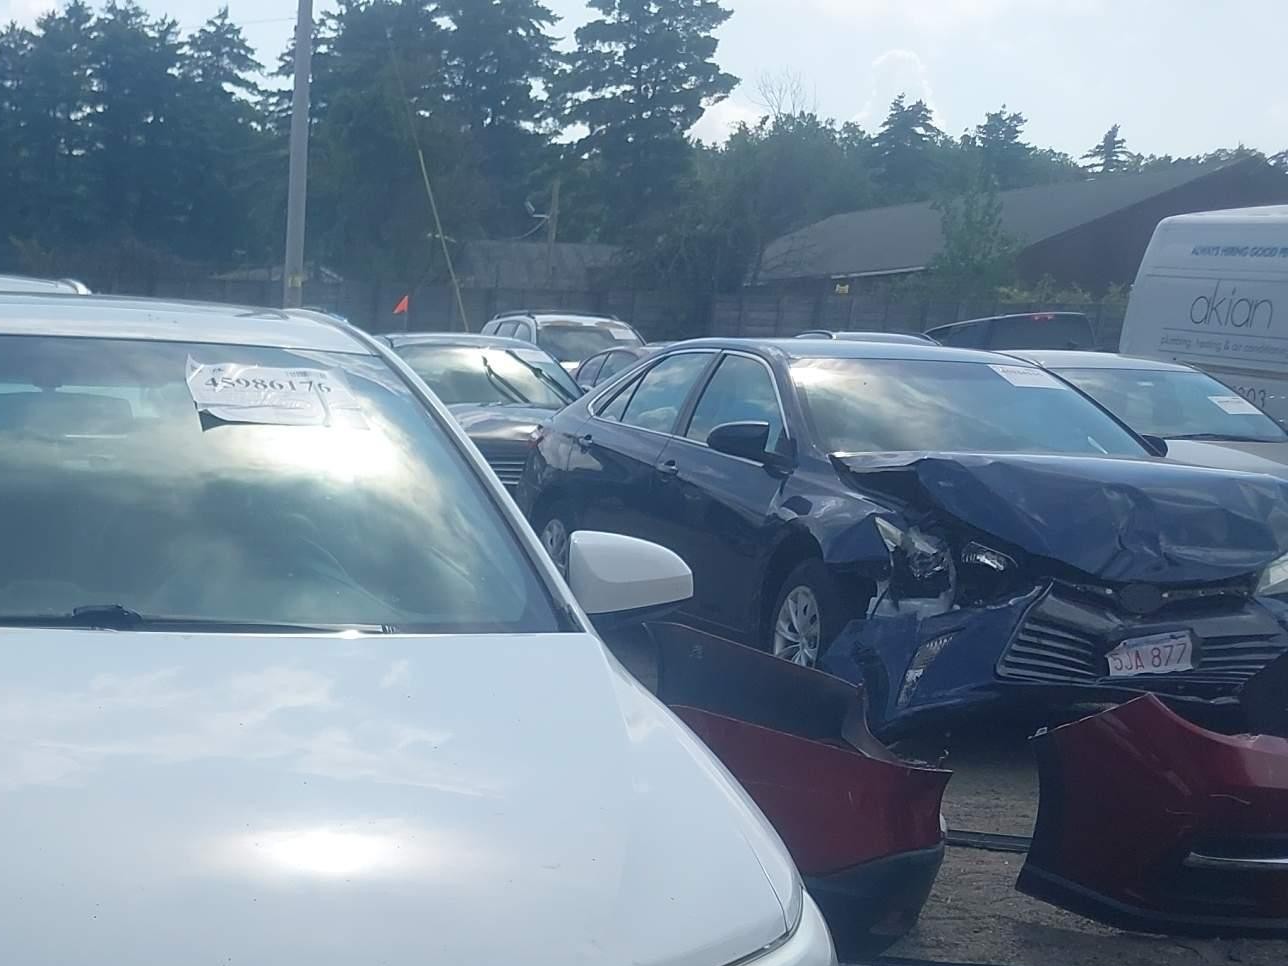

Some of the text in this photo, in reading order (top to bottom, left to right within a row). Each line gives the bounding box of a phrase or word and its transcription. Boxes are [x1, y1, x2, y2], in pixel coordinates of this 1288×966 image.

[1250, 247, 1277, 258] GOOD
[1190, 279, 1273, 328] akian
[1111, 643, 1187, 671] 5JA 877
